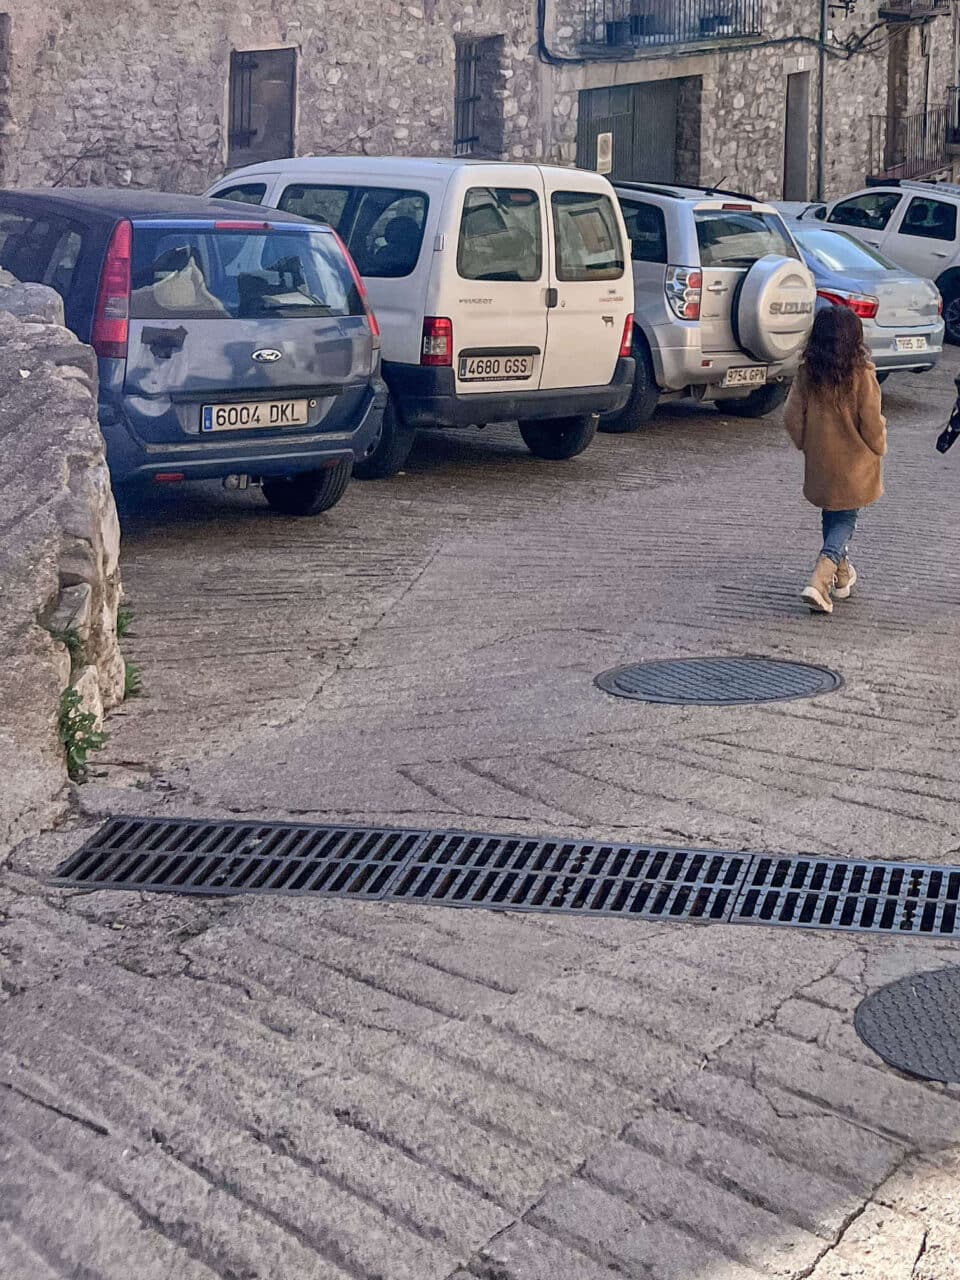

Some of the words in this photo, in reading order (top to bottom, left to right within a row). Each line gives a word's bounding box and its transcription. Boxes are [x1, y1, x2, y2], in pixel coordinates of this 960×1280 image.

[468, 359, 500, 375] 4680
[504, 358, 527, 373] GSS
[216, 405, 261, 426] 6004
[269, 403, 300, 423] DKL
